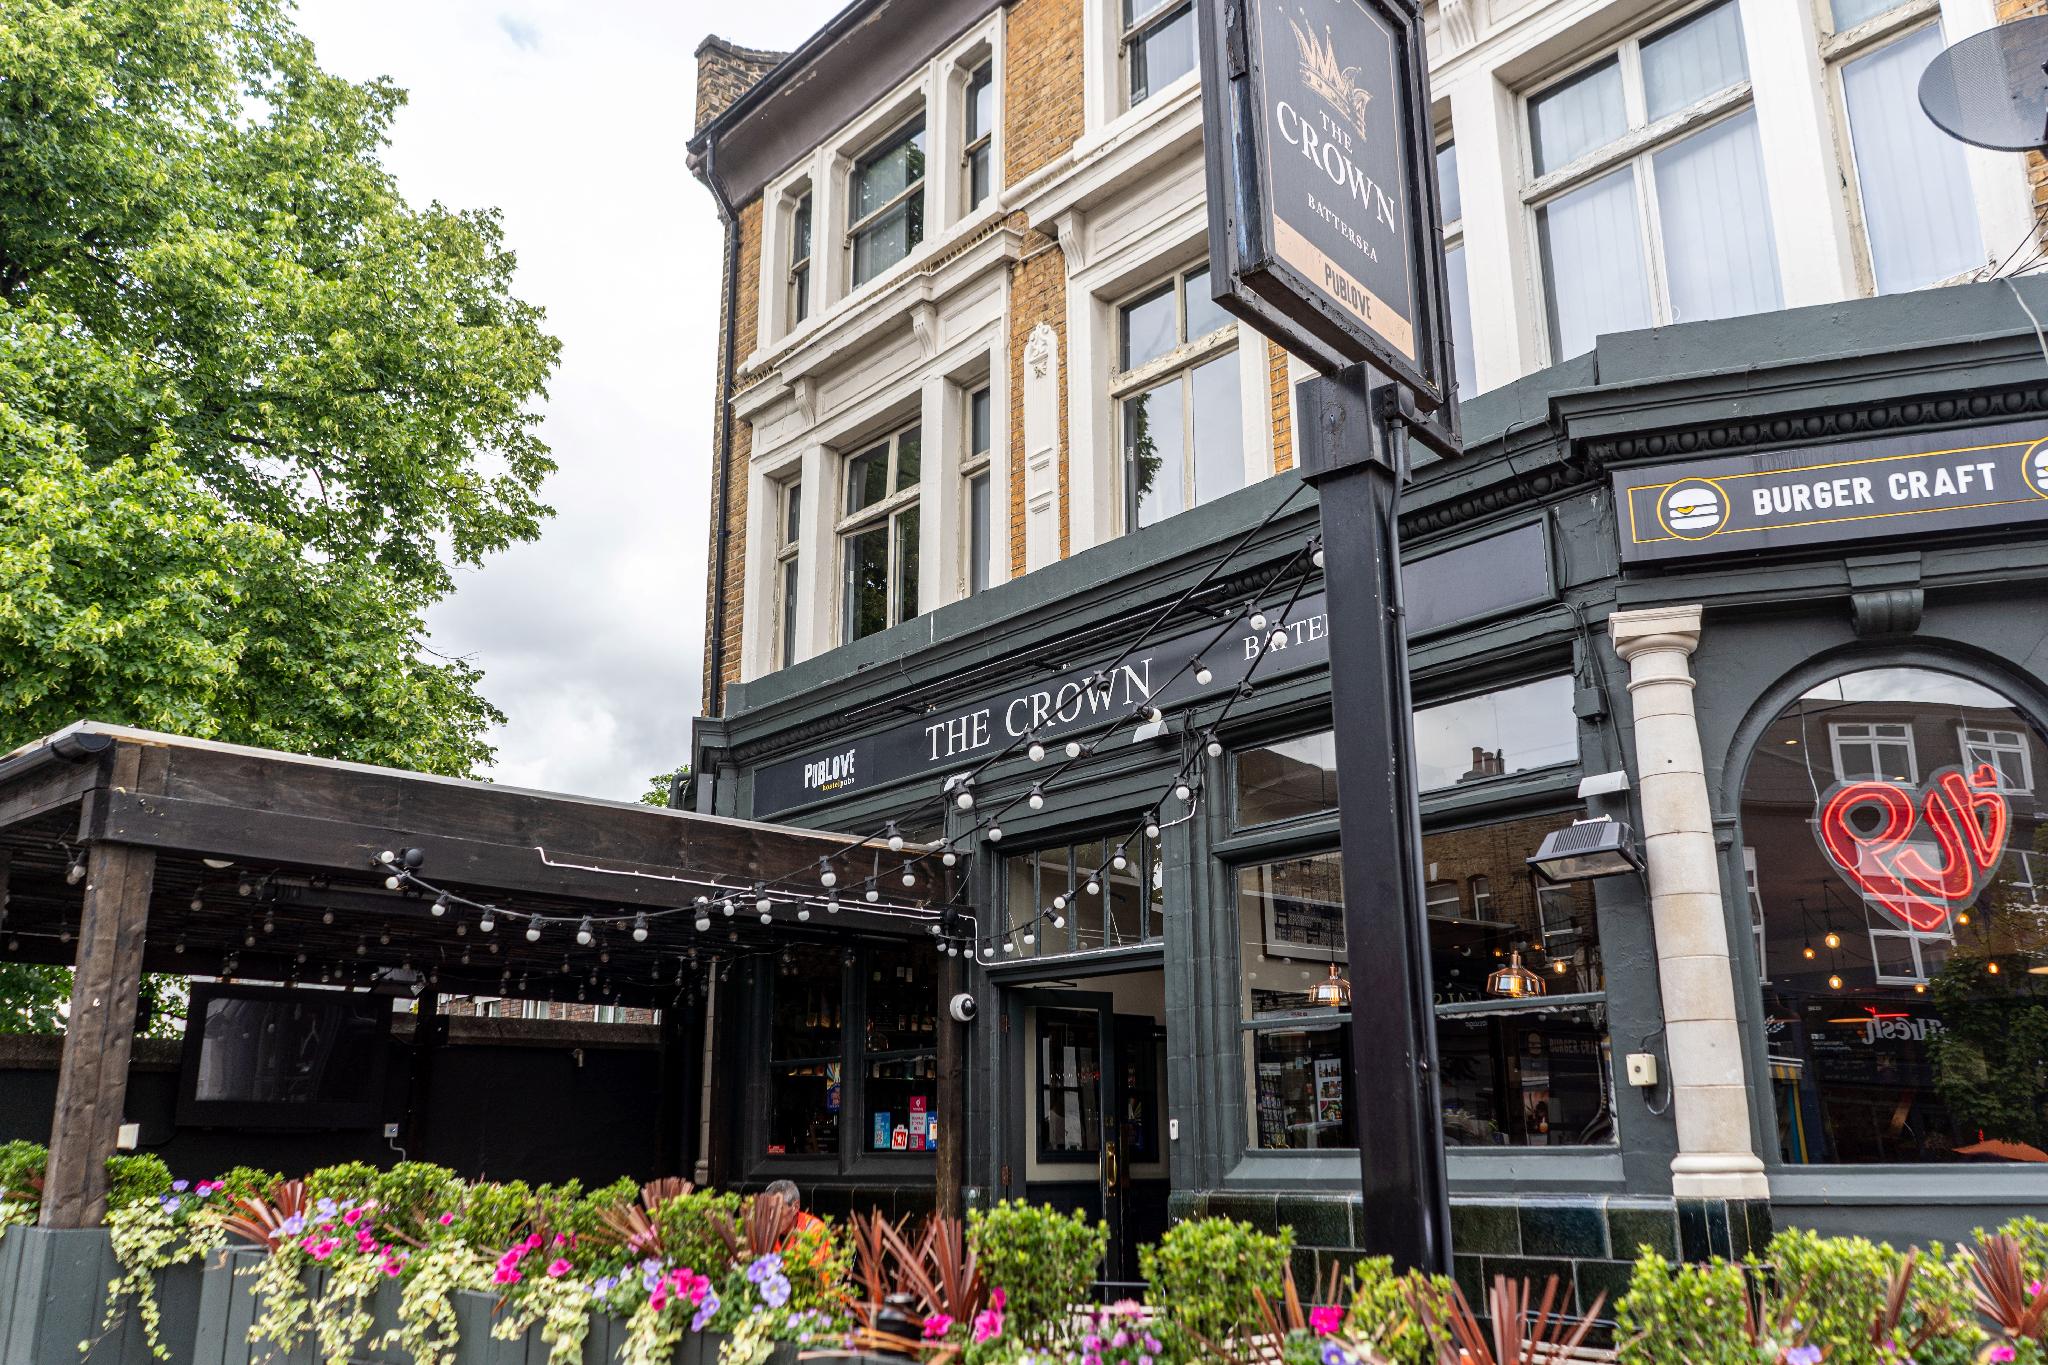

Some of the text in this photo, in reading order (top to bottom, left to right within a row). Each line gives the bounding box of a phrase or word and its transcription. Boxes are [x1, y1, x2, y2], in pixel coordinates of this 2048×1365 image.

[1318, 109, 1354, 155] THE
[1276, 100, 1397, 234] CROWN
[1307, 193, 1379, 265] BATTERSEA
[1324, 262, 1373, 321] PUBLOVE
[1752, 462, 1997, 516] BURGER CRAFT
[925, 657, 1154, 762] THE CROWN
[804, 748, 856, 789] PUBLOVE
